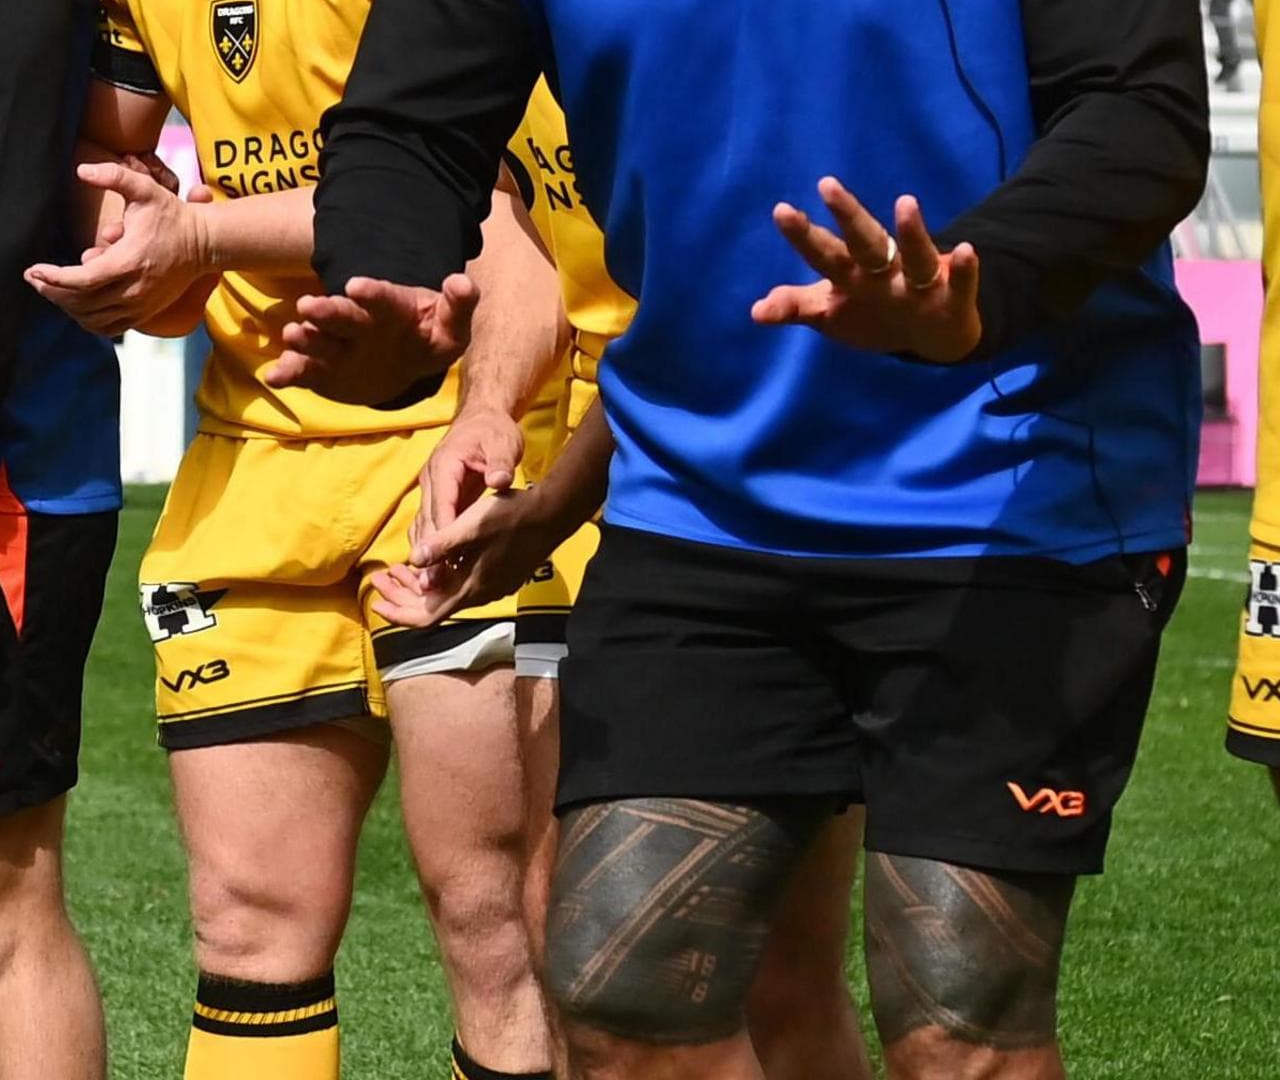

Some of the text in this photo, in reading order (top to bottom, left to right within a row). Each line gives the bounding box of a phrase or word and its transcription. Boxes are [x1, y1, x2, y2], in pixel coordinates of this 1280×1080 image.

[214, 128, 326, 169] DRAGO
[160, 659, 230, 693] VX3
[1006, 780, 1086, 817] VX3
